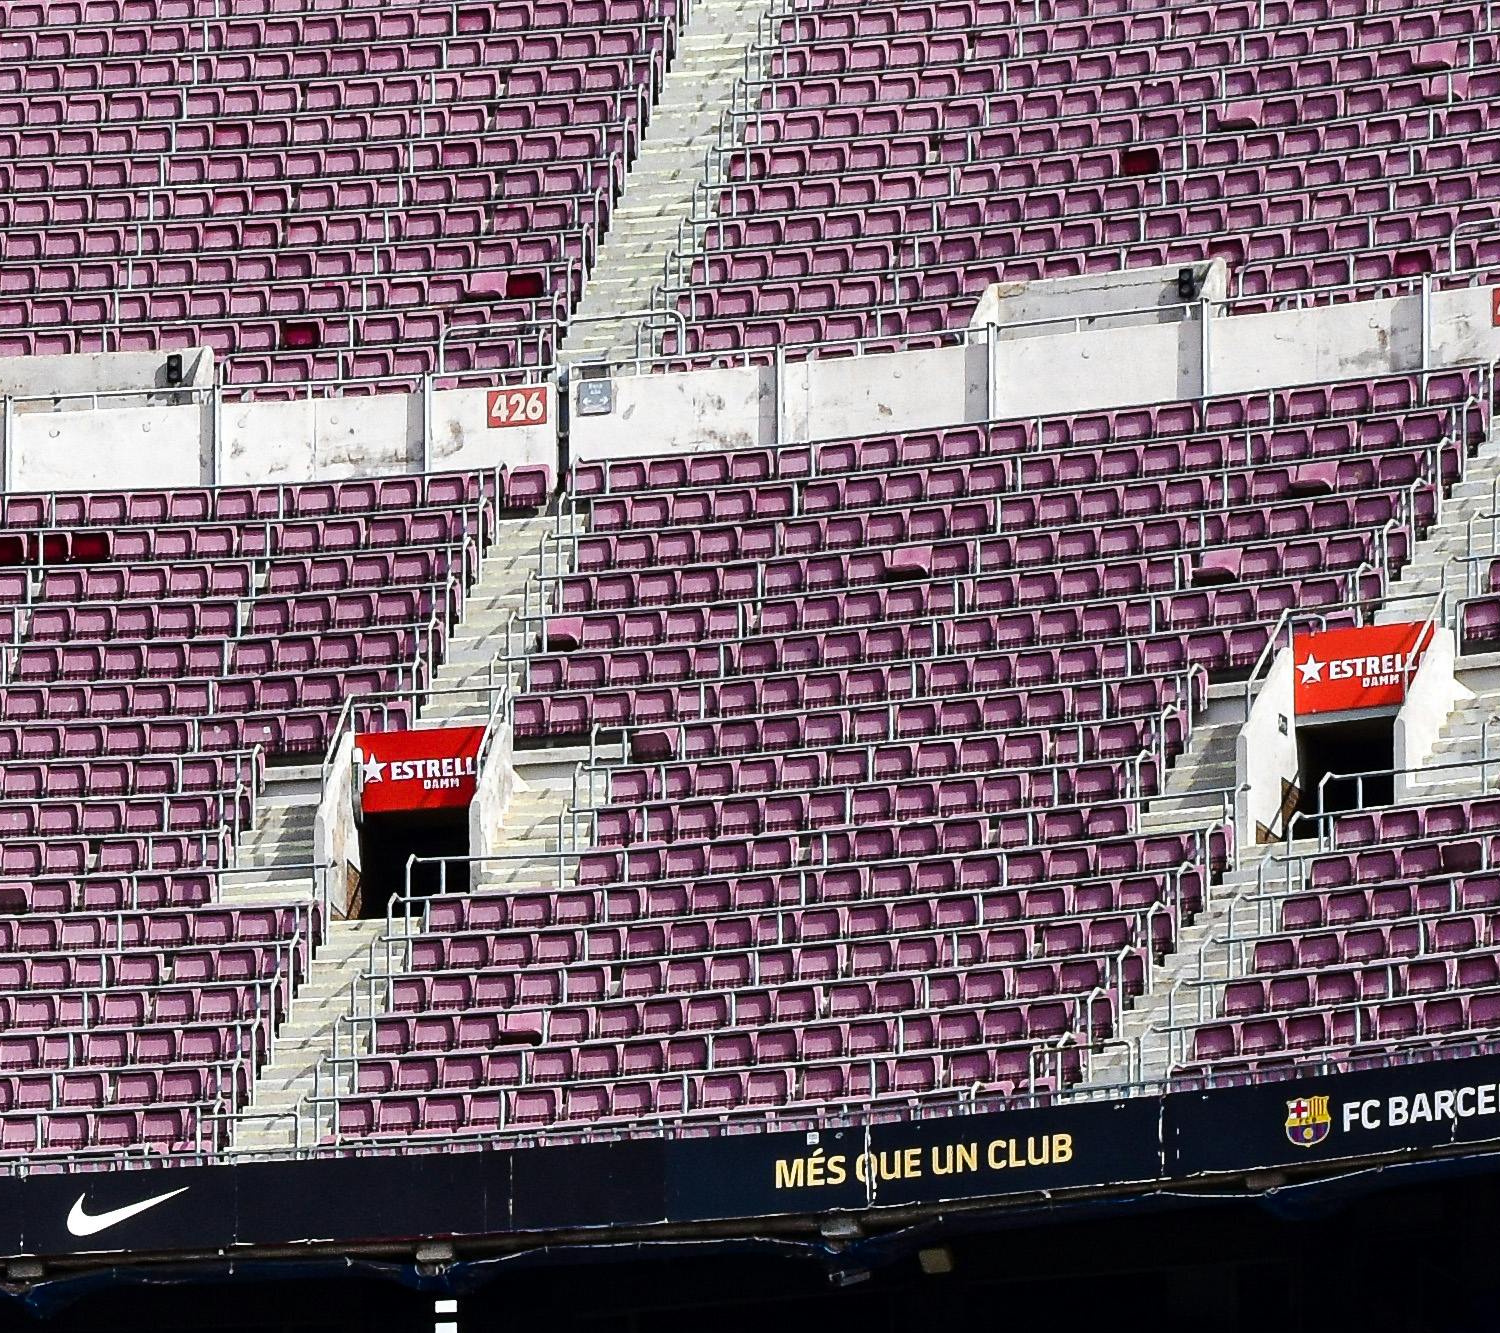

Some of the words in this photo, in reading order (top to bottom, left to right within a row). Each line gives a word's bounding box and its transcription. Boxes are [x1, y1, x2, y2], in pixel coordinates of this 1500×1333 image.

[491, 392, 543, 422] 426
[1362, 674, 1399, 687] DAMM
[423, 777, 460, 790] DAMM
[1342, 1099, 1381, 1132] FC
[775, 1148, 847, 1189] MÉS
[855, 1148, 922, 1184] QUE
[932, 1142, 978, 1175] UN
[987, 1133, 1073, 1170] CLUB
